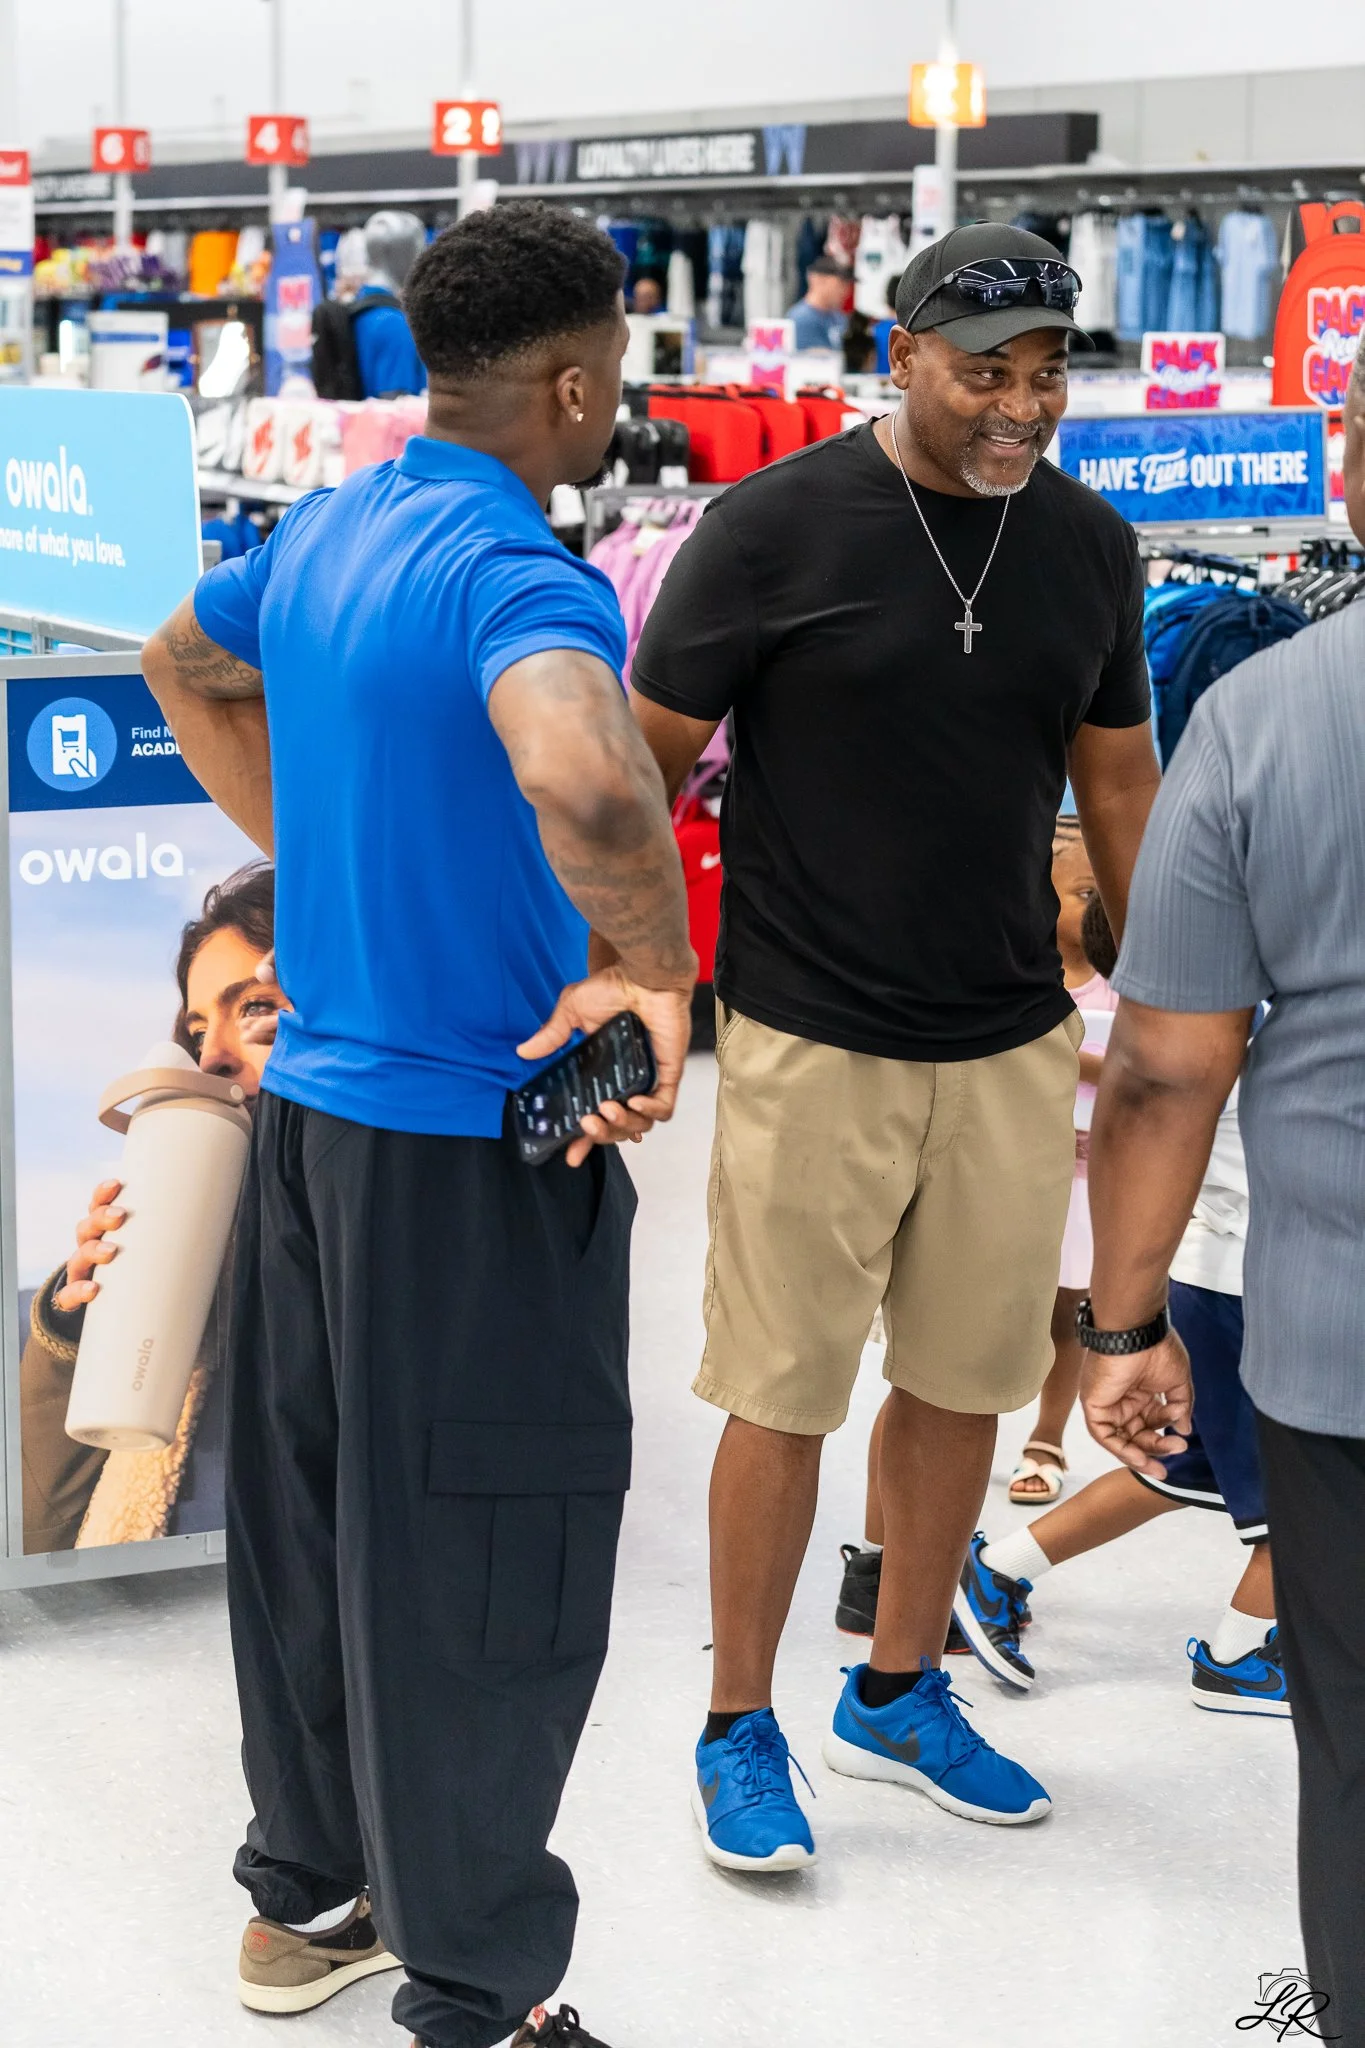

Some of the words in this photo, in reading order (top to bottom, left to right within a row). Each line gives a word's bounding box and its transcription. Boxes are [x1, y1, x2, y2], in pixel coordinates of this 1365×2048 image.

[254, 121, 281, 155] 4
[442, 107, 472, 146] 2
[1313, 293, 1365, 338] PAC
[1079, 457, 1140, 491] HAVE
[1140, 448, 1190, 494] Fun
[1190, 454, 1239, 488] OUT
[1238, 451, 1309, 486] THERE
[25, 524, 37, 552] of
[38, 527, 69, 557] what
[71, 538, 94, 567] you
[95, 532, 126, 567] love.
[131, 726, 161, 739] Find
[132, 1338, 154, 1392] owala
